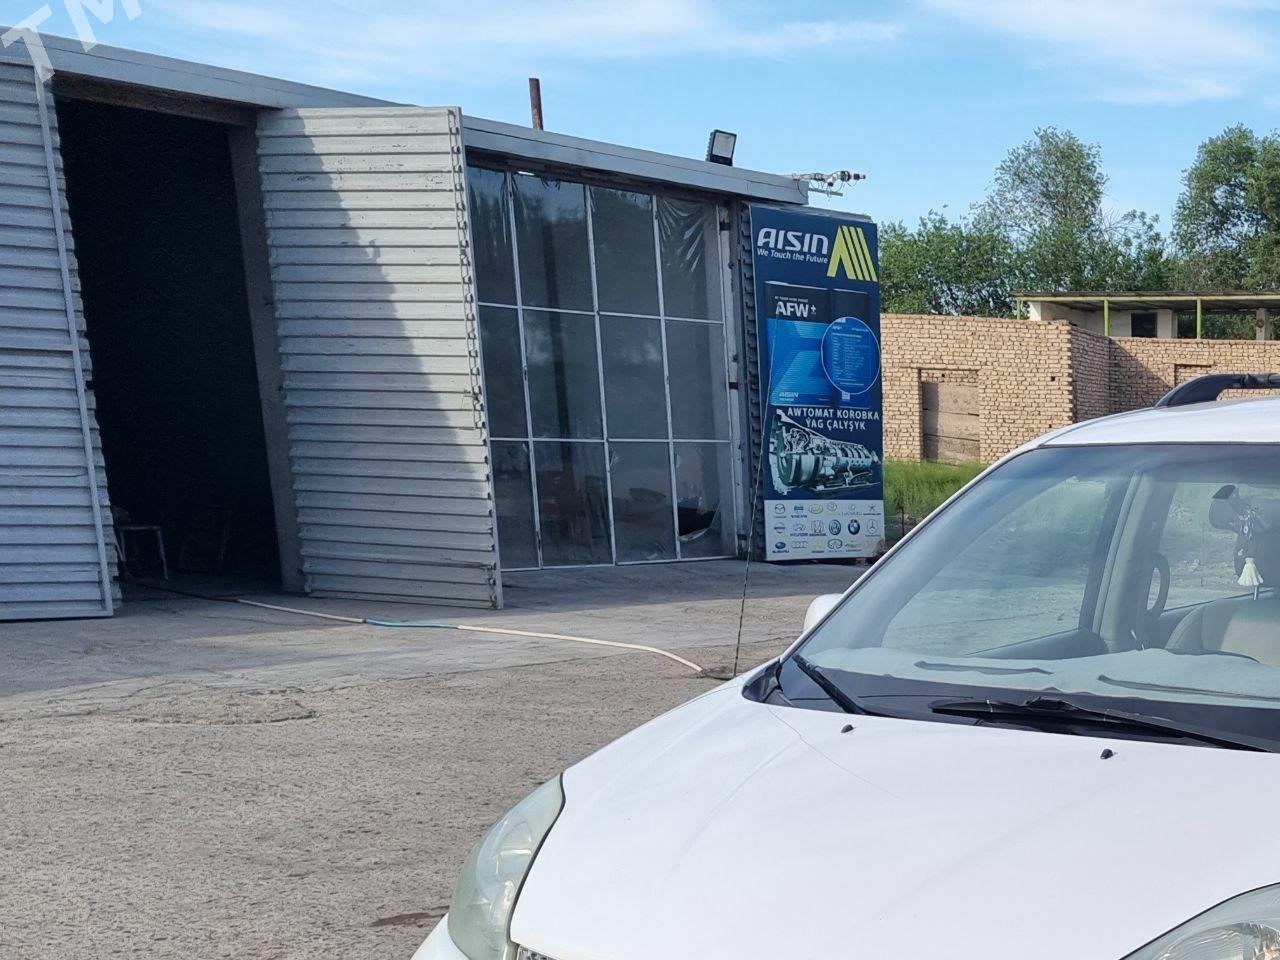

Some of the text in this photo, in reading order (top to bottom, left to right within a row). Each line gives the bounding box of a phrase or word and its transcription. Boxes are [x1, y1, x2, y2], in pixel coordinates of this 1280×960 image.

[757, 228, 828, 254] AISIN
[757, 248, 828, 264] We Touch the Future
[787, 407, 880, 420] AWTOMAT KOROBKA
[827, 419, 866, 432] ÇALYŞYK
